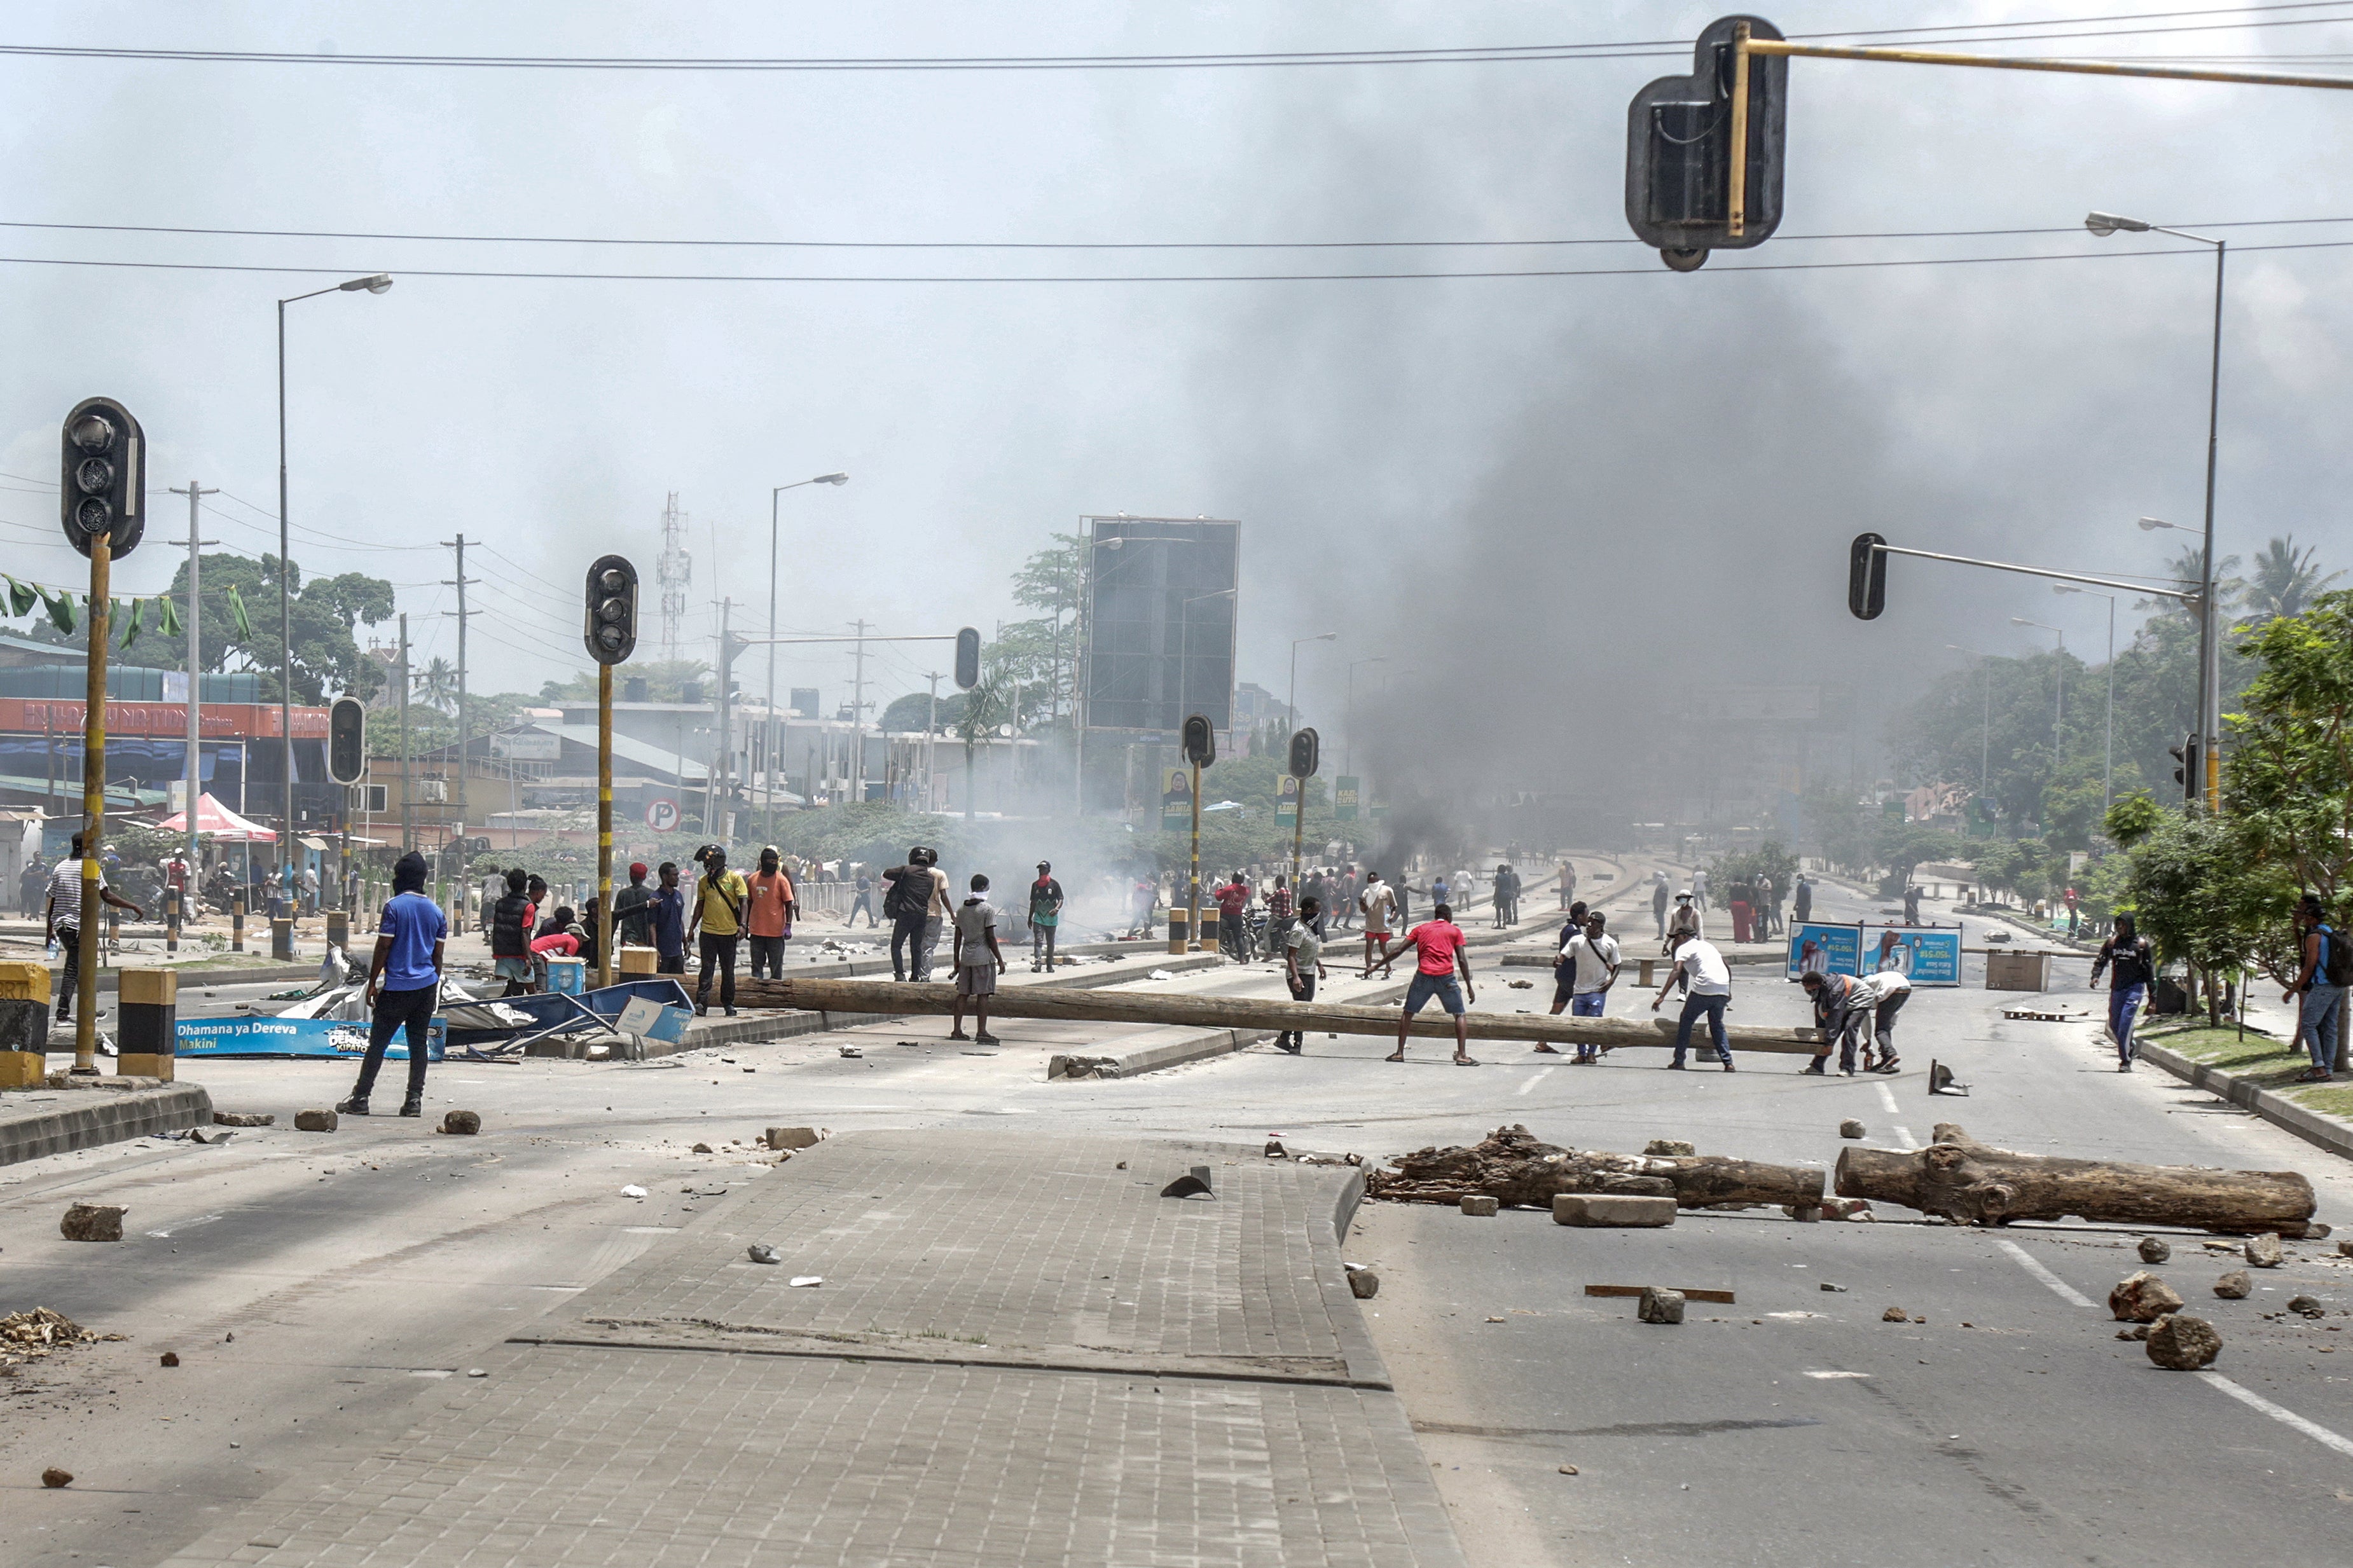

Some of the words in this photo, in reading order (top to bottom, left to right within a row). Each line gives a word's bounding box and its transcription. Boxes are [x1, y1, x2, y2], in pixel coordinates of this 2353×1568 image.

[656, 804, 673, 826] P
[178, 1025, 232, 1036] Dhamana
[235, 1024, 249, 1036] ya
[252, 1022, 297, 1035] Dereva
[179, 1038, 217, 1050] Makini
[336, 1043, 368, 1054] KIPATO
